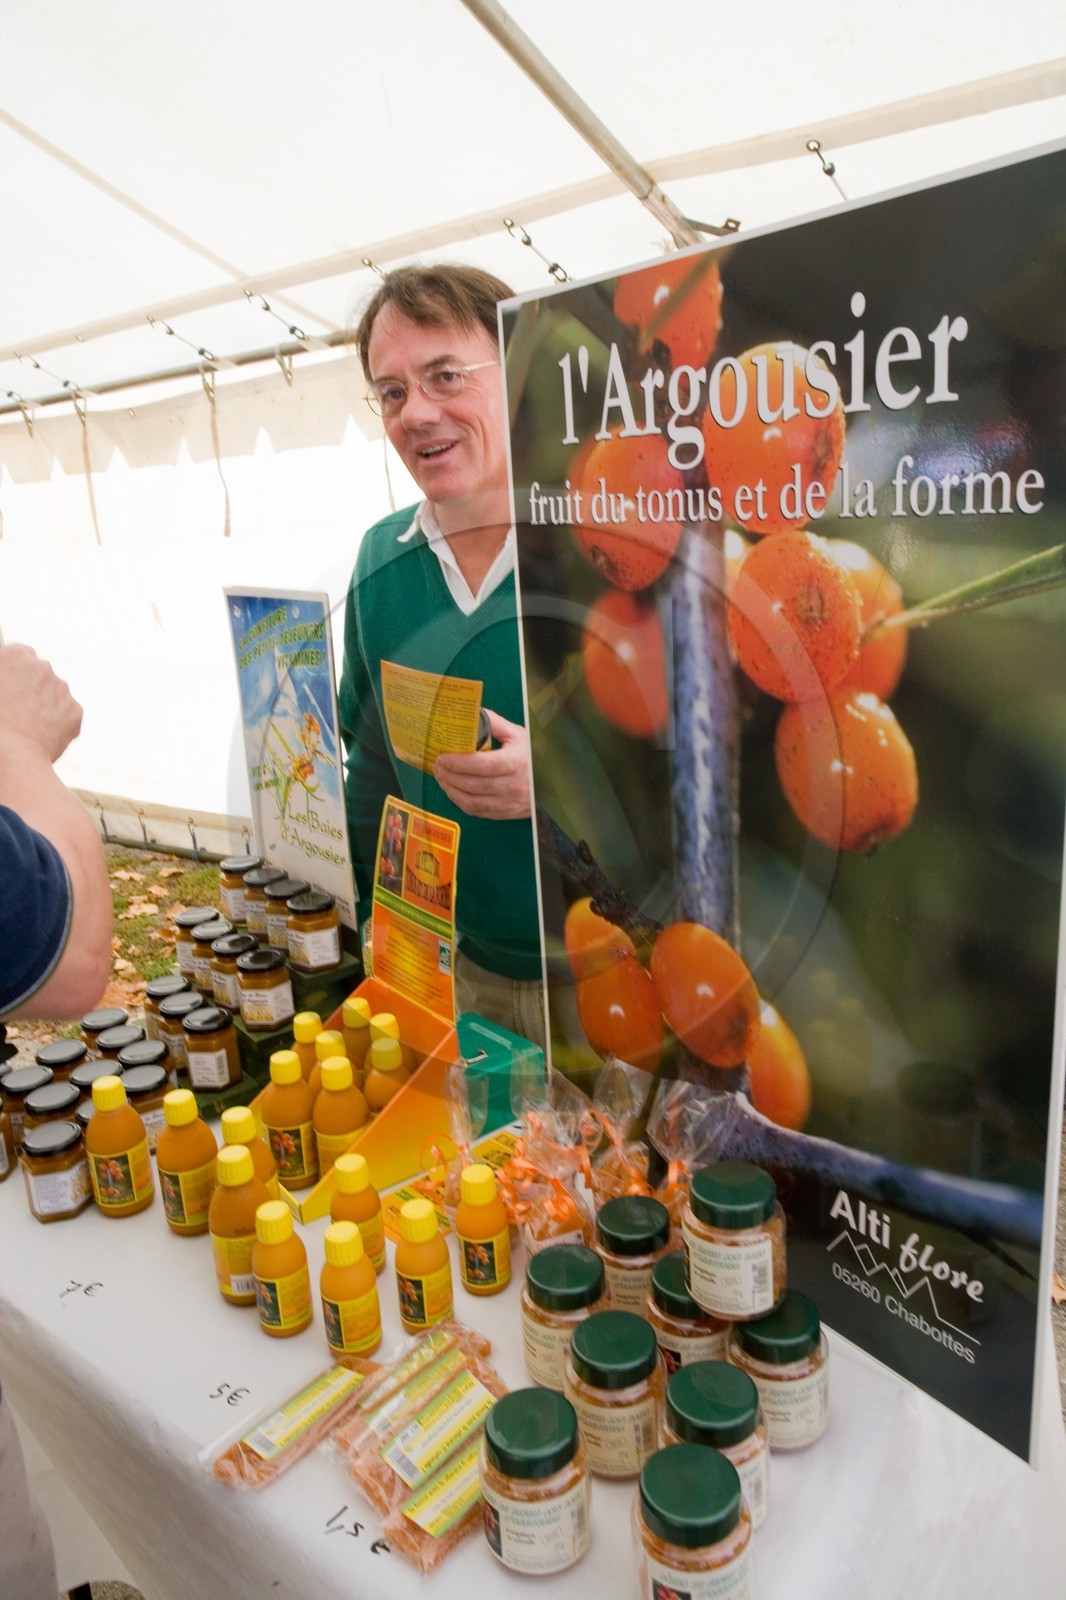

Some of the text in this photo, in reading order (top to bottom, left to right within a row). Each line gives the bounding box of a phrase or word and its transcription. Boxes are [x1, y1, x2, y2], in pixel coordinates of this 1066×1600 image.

[559, 291, 968, 470] l'Argousier
[529, 456, 1044, 525] fruit du tonus et de la forme
[288, 801, 344, 840] Les Baies
[829, 1189, 984, 1303] Alti flore
[832, 1262, 975, 1364] 05260 Chabottes
